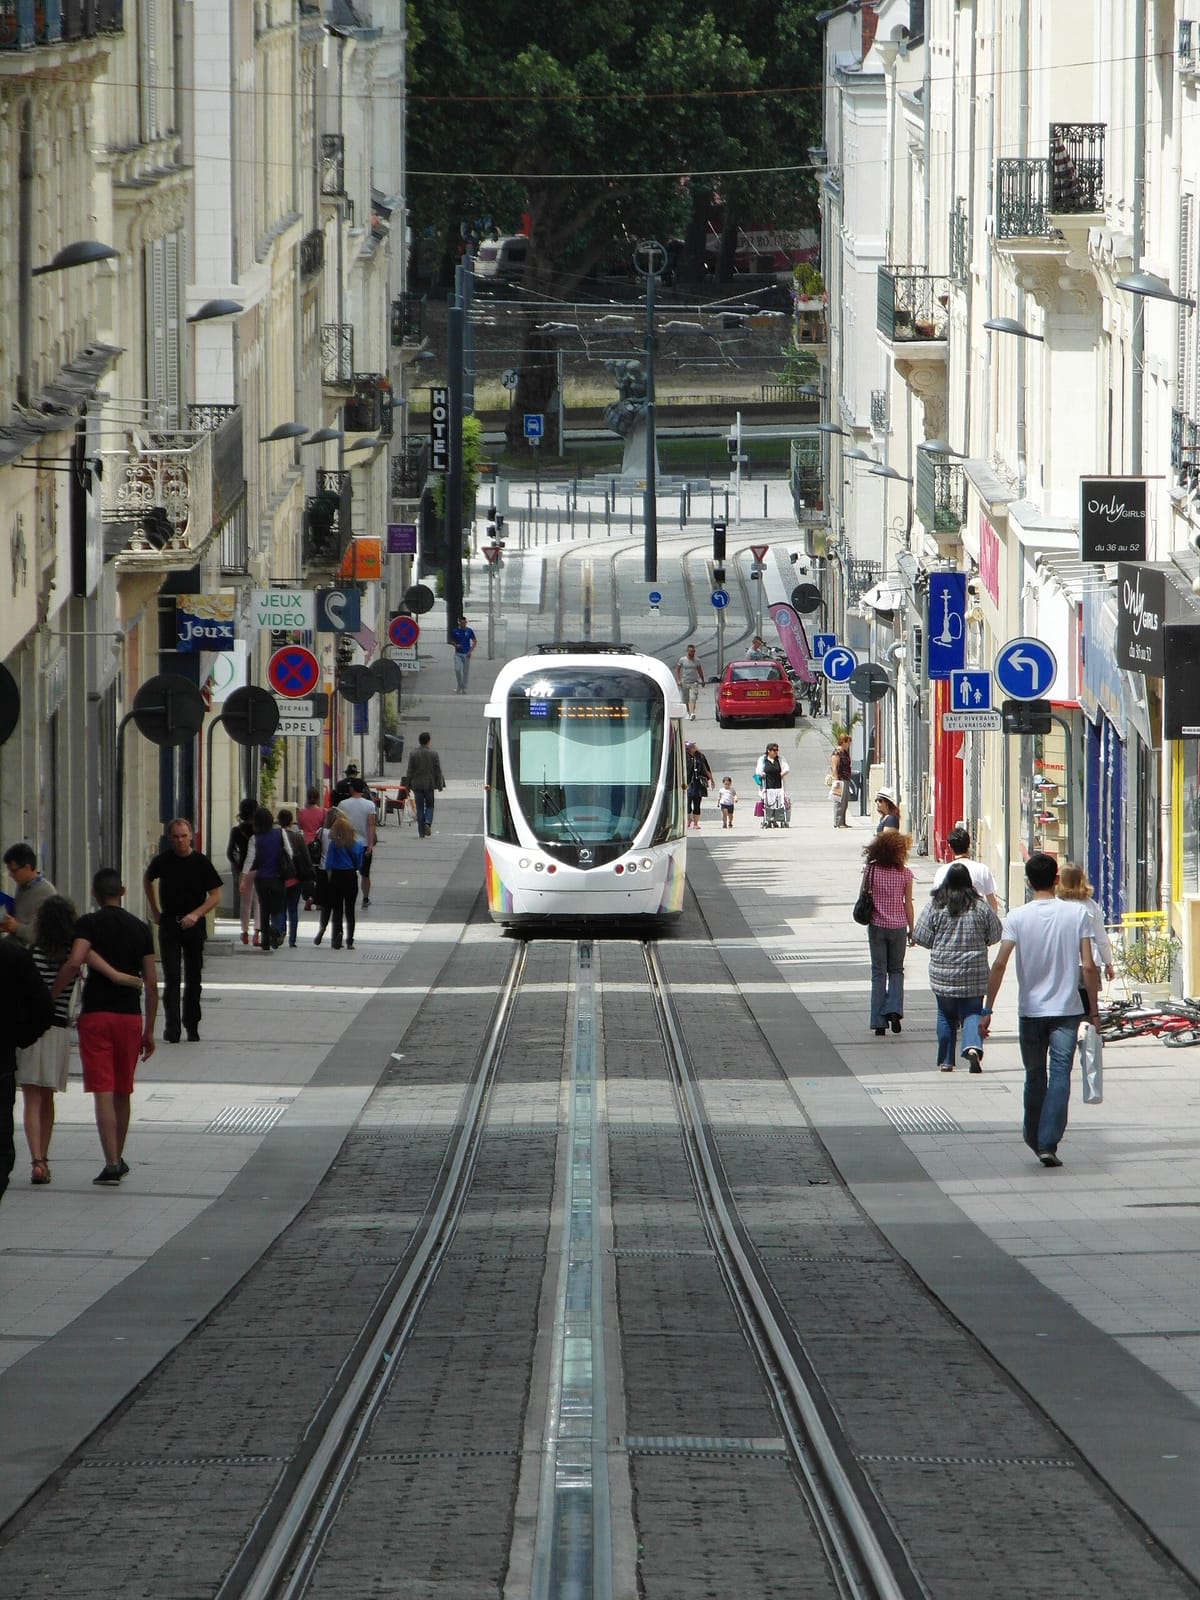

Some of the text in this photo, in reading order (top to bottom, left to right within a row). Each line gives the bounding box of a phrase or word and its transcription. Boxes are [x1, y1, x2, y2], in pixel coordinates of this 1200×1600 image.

[432, 390, 446, 469] HOTEL
[1087, 495, 1146, 523] Only GIRLS
[260, 594, 302, 608] JEUX
[1123, 571, 1158, 636] Only GIRLS
[257, 610, 306, 627] VIDÉO
[178, 621, 233, 641] Jeux
[276, 722, 315, 732] APPEL
